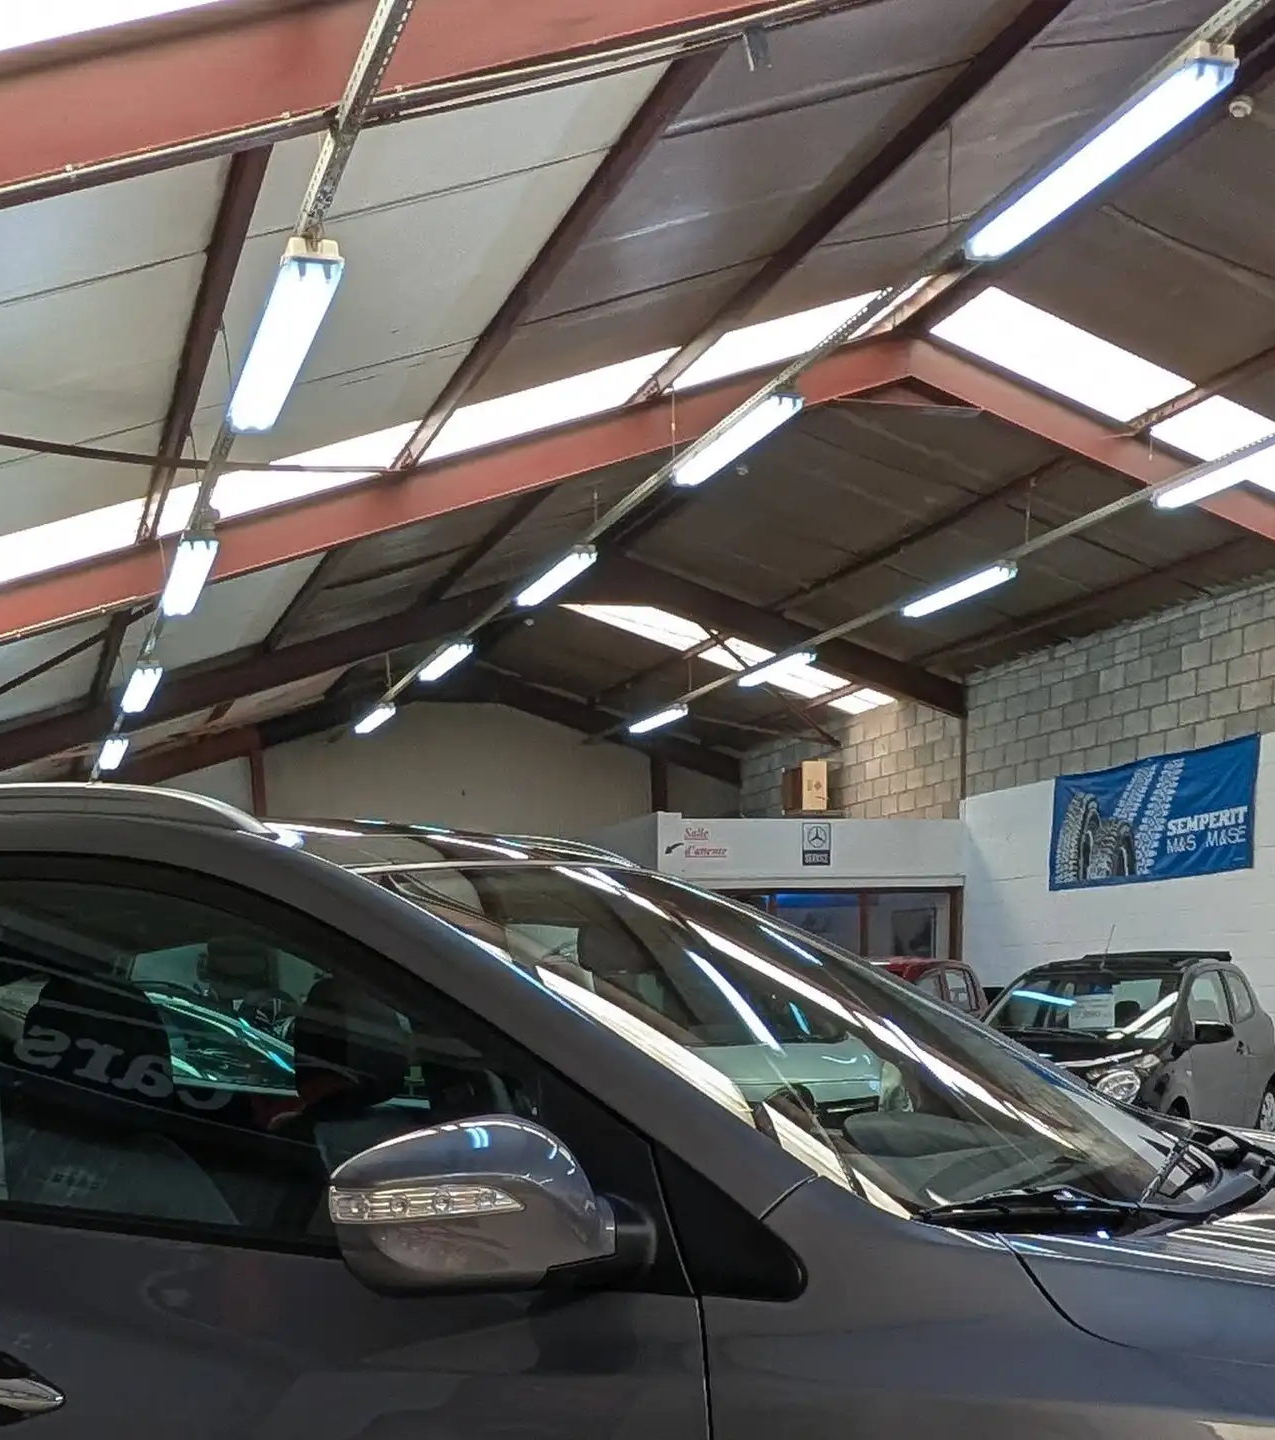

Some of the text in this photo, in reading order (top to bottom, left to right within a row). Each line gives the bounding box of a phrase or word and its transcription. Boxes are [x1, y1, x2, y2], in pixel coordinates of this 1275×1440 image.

[1167, 805, 1248, 837] SEMPERIT
[1167, 825, 1247, 854] M&S M&SE
